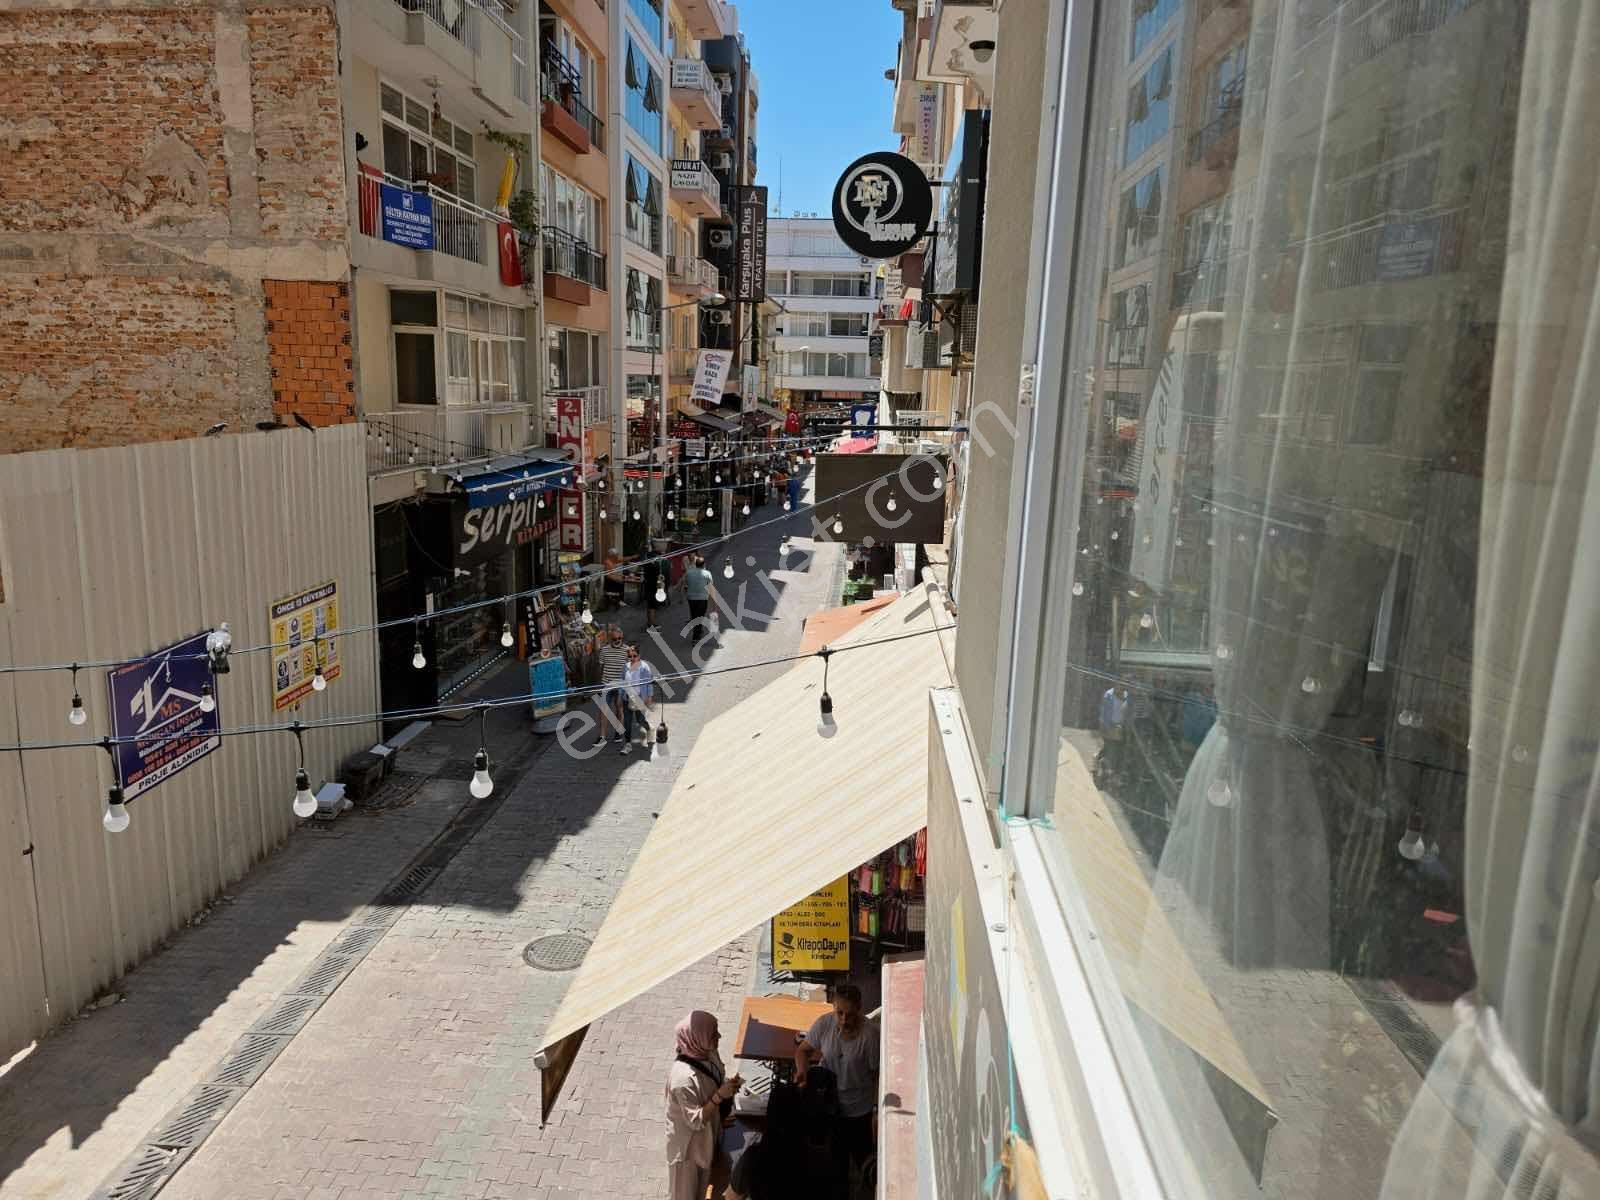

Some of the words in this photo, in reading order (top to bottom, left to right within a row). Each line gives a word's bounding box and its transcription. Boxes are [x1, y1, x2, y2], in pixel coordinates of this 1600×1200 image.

[673, 161, 701, 170] AVUKAT
[742, 207, 752, 233] Plus
[560, 415, 582, 545] NOER
[138, 768, 168, 790] PROJE
[171, 743, 209, 771] ALANIDIR
